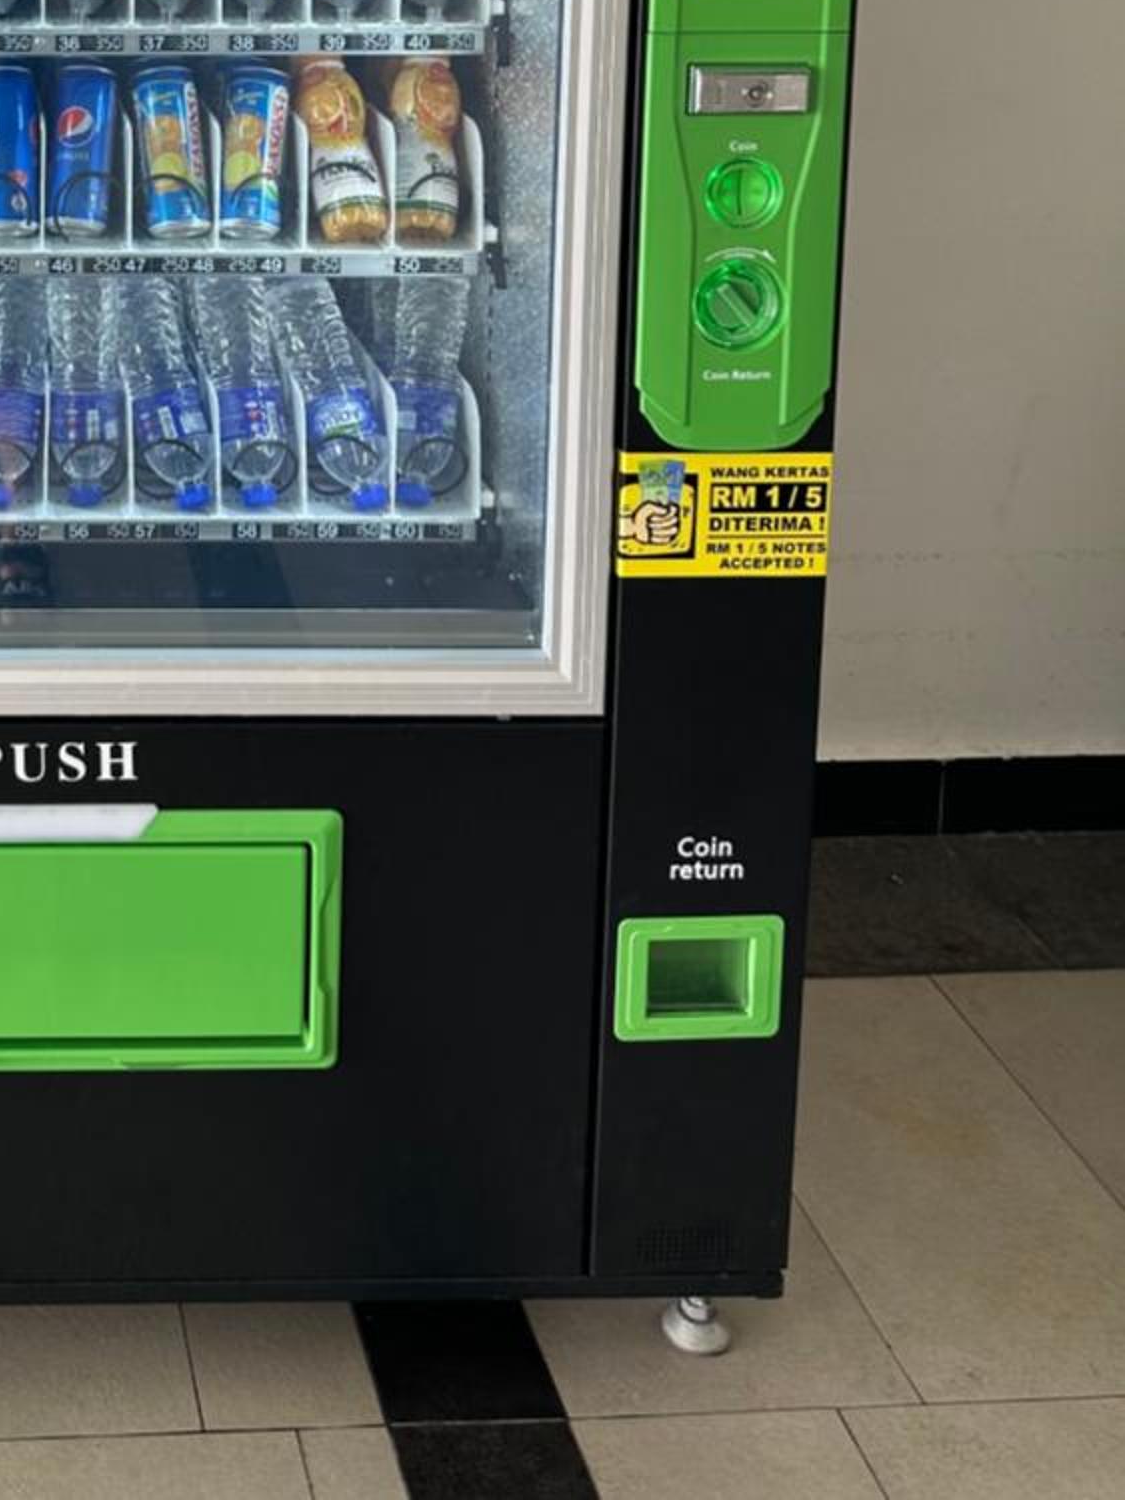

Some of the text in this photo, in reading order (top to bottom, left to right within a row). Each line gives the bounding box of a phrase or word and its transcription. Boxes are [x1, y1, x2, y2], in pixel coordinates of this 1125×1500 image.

[143, 36, 162, 49] 37
[233, 36, 253, 49] 38
[325, 36, 345, 49] 39
[410, 36, 430, 49] 40
[729, 139, 758, 152] Coin
[52, 261, 73, 274] 46
[126, 260, 145, 273] 47
[194, 260, 213, 273] 48
[261, 260, 283, 273] 49
[399, 260, 420, 273] 50
[703, 369, 771, 382] Coin Return
[710, 466, 829, 479] WANG KERTAS
[712, 486, 755, 509] RM
[765, 486, 779, 508] 1
[805, 486, 823, 508] 5
[709, 517, 812, 532] DITERIMA
[68, 526, 89, 539] 56
[135, 526, 155, 539] 57
[236, 526, 257, 539] 58
[317, 526, 338, 539] 59
[394, 525, 415, 538] 60
[706, 543, 730, 555] RM
[758, 544, 767, 554] 5
[772, 543, 827, 554] NOTES
[720, 558, 804, 569] ACCEPTED
[677, 836, 733, 858] Coin
[669, 861, 744, 880] return
